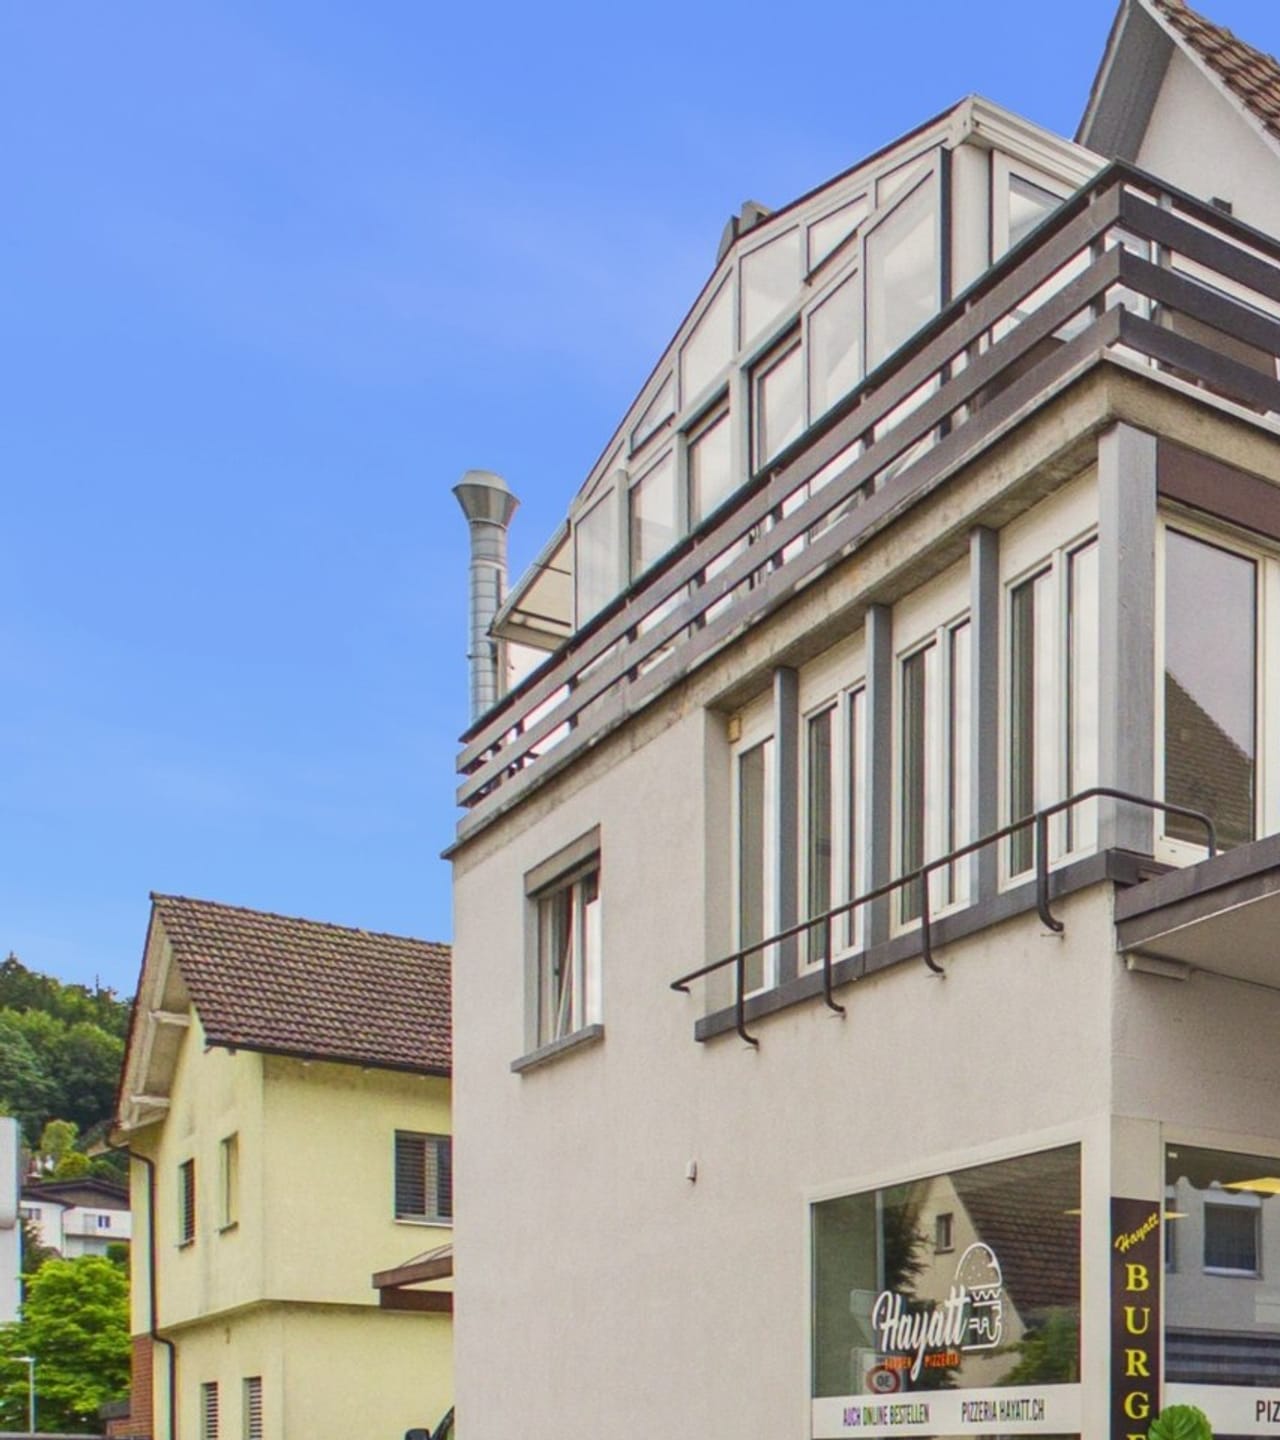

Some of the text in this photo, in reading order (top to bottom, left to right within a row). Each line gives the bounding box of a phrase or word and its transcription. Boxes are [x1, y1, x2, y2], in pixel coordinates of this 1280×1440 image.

[1114, 1212, 1159, 1252] Hayatt
[872, 1285, 971, 1382] Hayatt
[843, 1403, 930, 1426] AUCH ONLINE BESTELLEN
[961, 1401, 998, 1423] PIZZERIA
